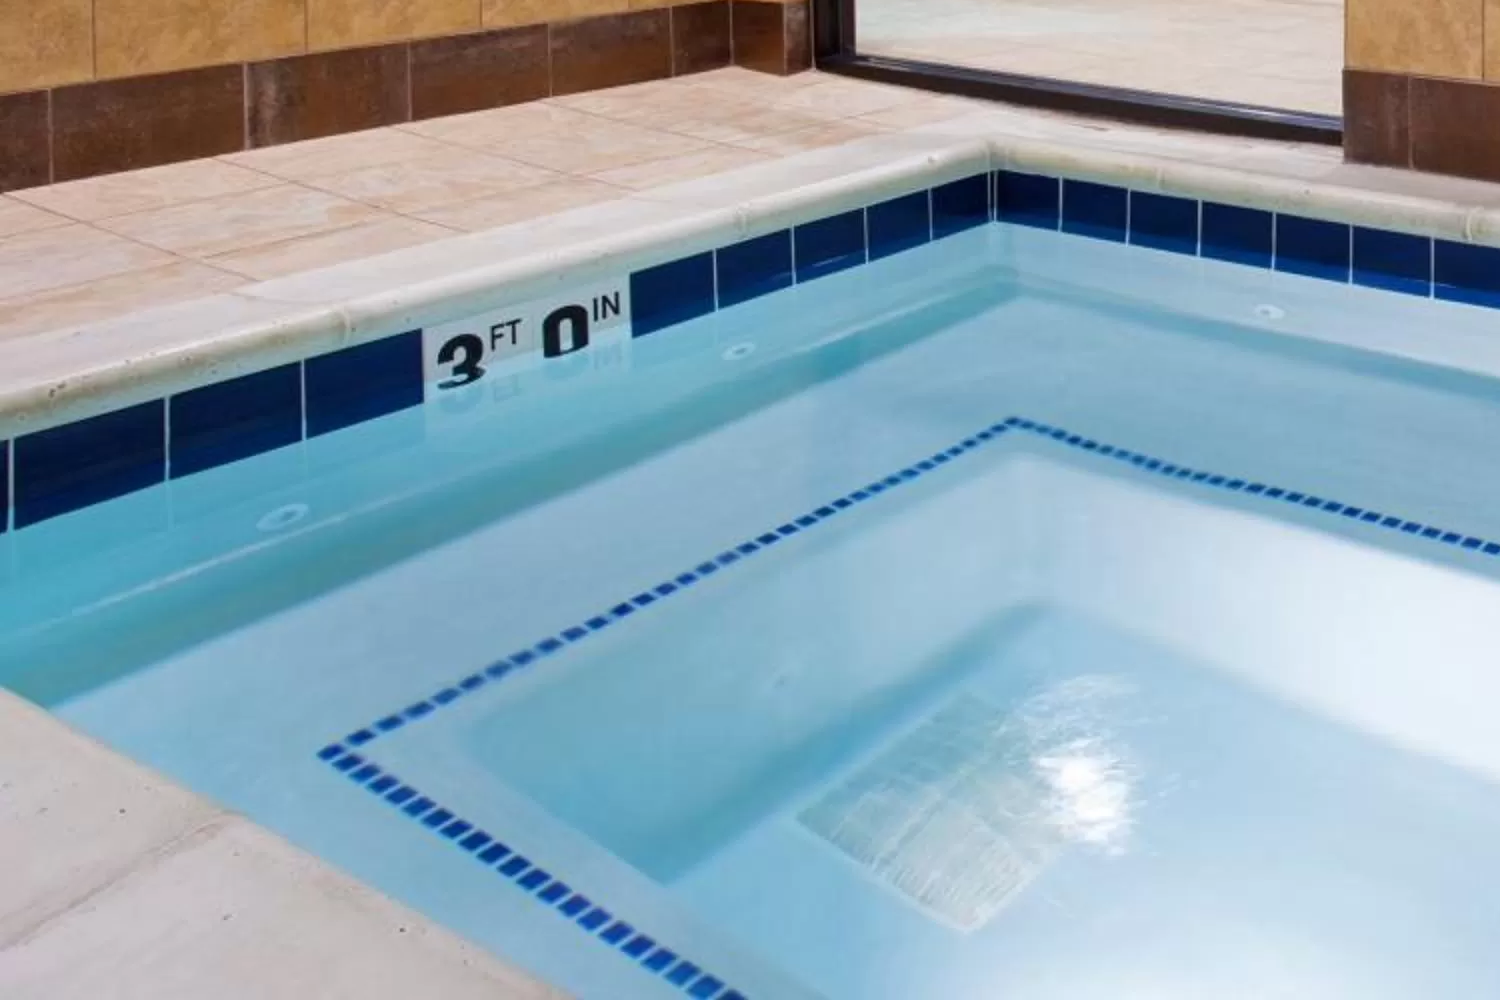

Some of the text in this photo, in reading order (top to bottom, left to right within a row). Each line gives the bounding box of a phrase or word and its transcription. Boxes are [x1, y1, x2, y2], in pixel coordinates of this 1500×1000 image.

[436, 291, 621, 390] 3 FT 0 IN
